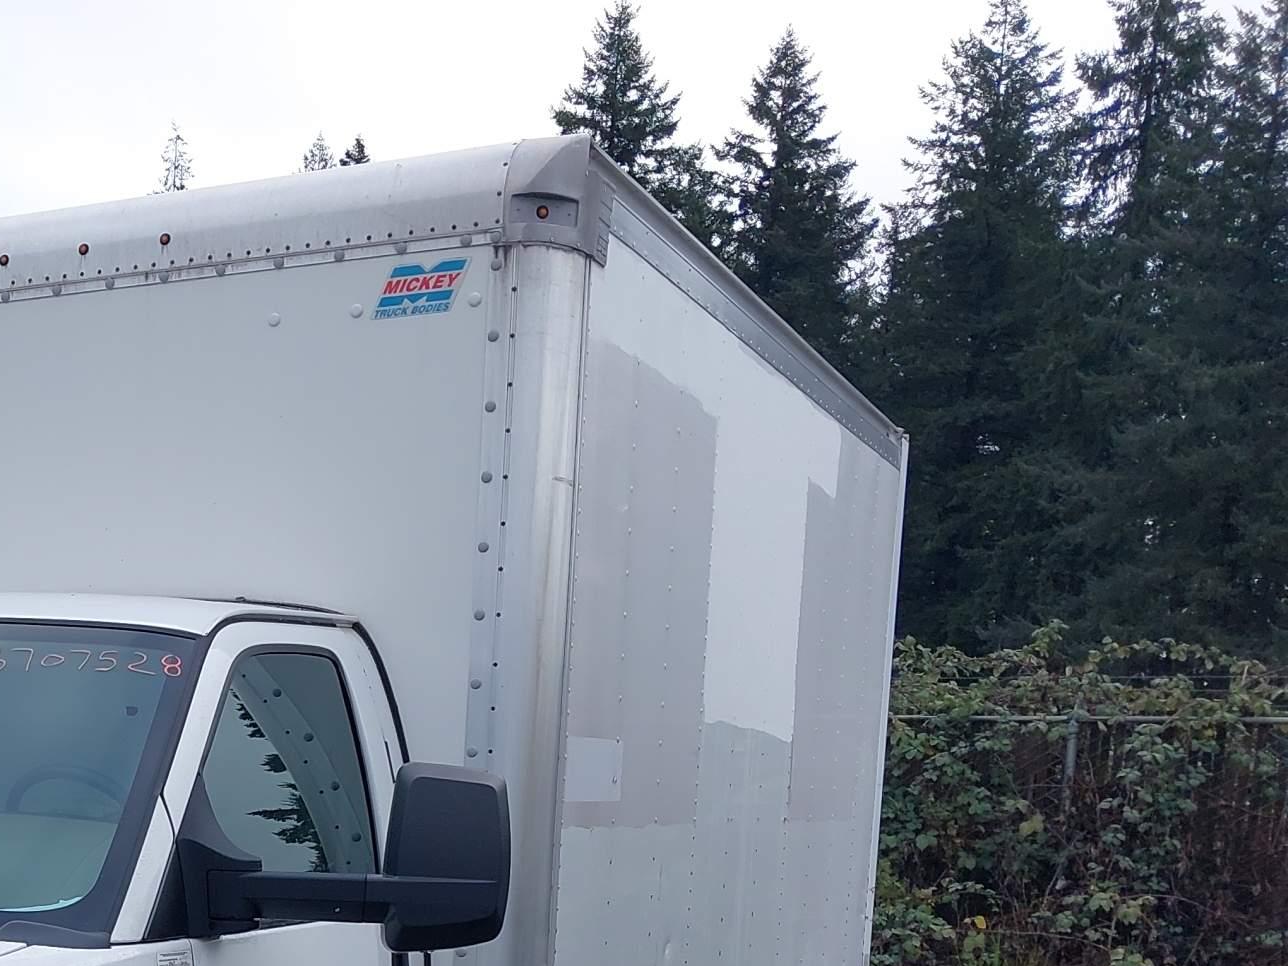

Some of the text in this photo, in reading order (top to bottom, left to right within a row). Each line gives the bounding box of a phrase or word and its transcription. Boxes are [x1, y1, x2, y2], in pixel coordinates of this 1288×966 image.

[383, 272, 462, 294] MICKEY
[374, 302, 450, 319] TRUCK BODIES
